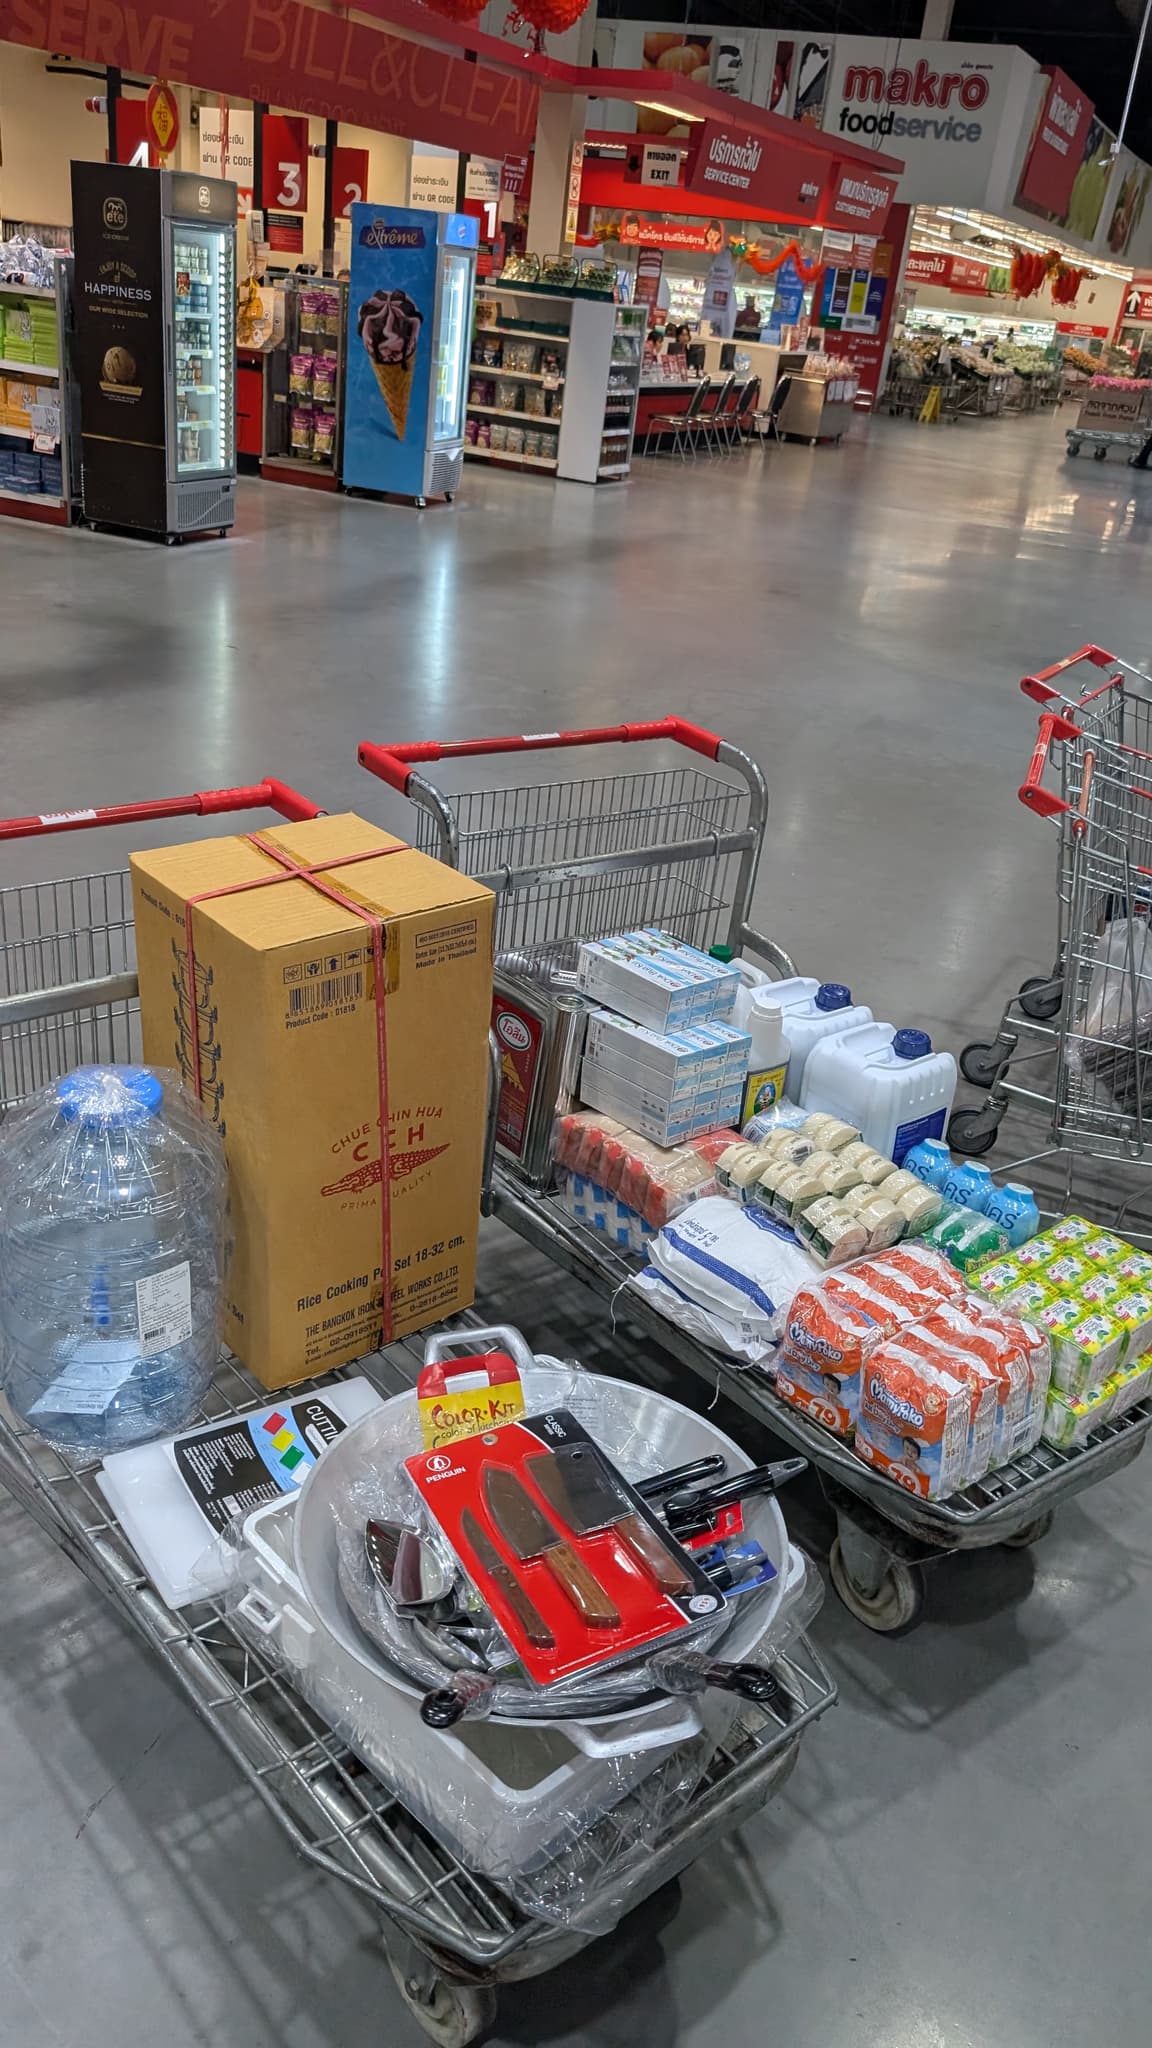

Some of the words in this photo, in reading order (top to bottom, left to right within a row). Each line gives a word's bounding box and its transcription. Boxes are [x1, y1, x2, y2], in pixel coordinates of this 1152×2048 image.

[243, 0, 543, 137] BILL&CLEA
[842, 59, 990, 112] makro
[233, 157, 253, 168] CODE
[647, 151, 677, 162] ทางออก
[709, 134, 763, 172] บริการทั่วไป
[277, 162, 301, 207] 3
[651, 169, 670, 181] EXIT
[704, 166, 728, 185] SERVICE
[342, 183, 362, 217] 2
[427, 194, 436, 204] QR
[438, 194, 455, 205] CODE
[484, 202, 497, 238] 1
[84, 281, 152, 301] HAPPINESS
[117, 308, 149, 319] SELECTION
[416, 959, 435, 970] Made
[286, 1014, 310, 1029] Product
[312, 1012, 328, 1023] Code
[335, 1004, 356, 1017] 01818
[331, 1123, 370, 1154] CHUE
[415, 1106, 443, 1119] HUA
[341, 1198, 377, 1210] PRIMA
[392, 1170, 432, 1199] UALITY
[297, 1294, 322, 1312] Rice
[326, 1274, 369, 1300] Cooking
[394, 1255, 412, 1272] Set
[415, 1242, 445, 1263] 18-32
[448, 1235, 466, 1250] cm.
[305, 1323, 320, 1338] THE
[322, 1309, 355, 1330] BANGKOK
[358, 1300, 376, 1316] IRON
[407, 1276, 432, 1295] WORKS
[306, 1346, 321, 1357] Tel.
[812, 1402, 836, 1427] 79
[870, 1377, 924, 1429] MamyPoko
[545, 1415, 568, 1439] CLASSIC
[425, 1466, 467, 1484] PENGUIN
